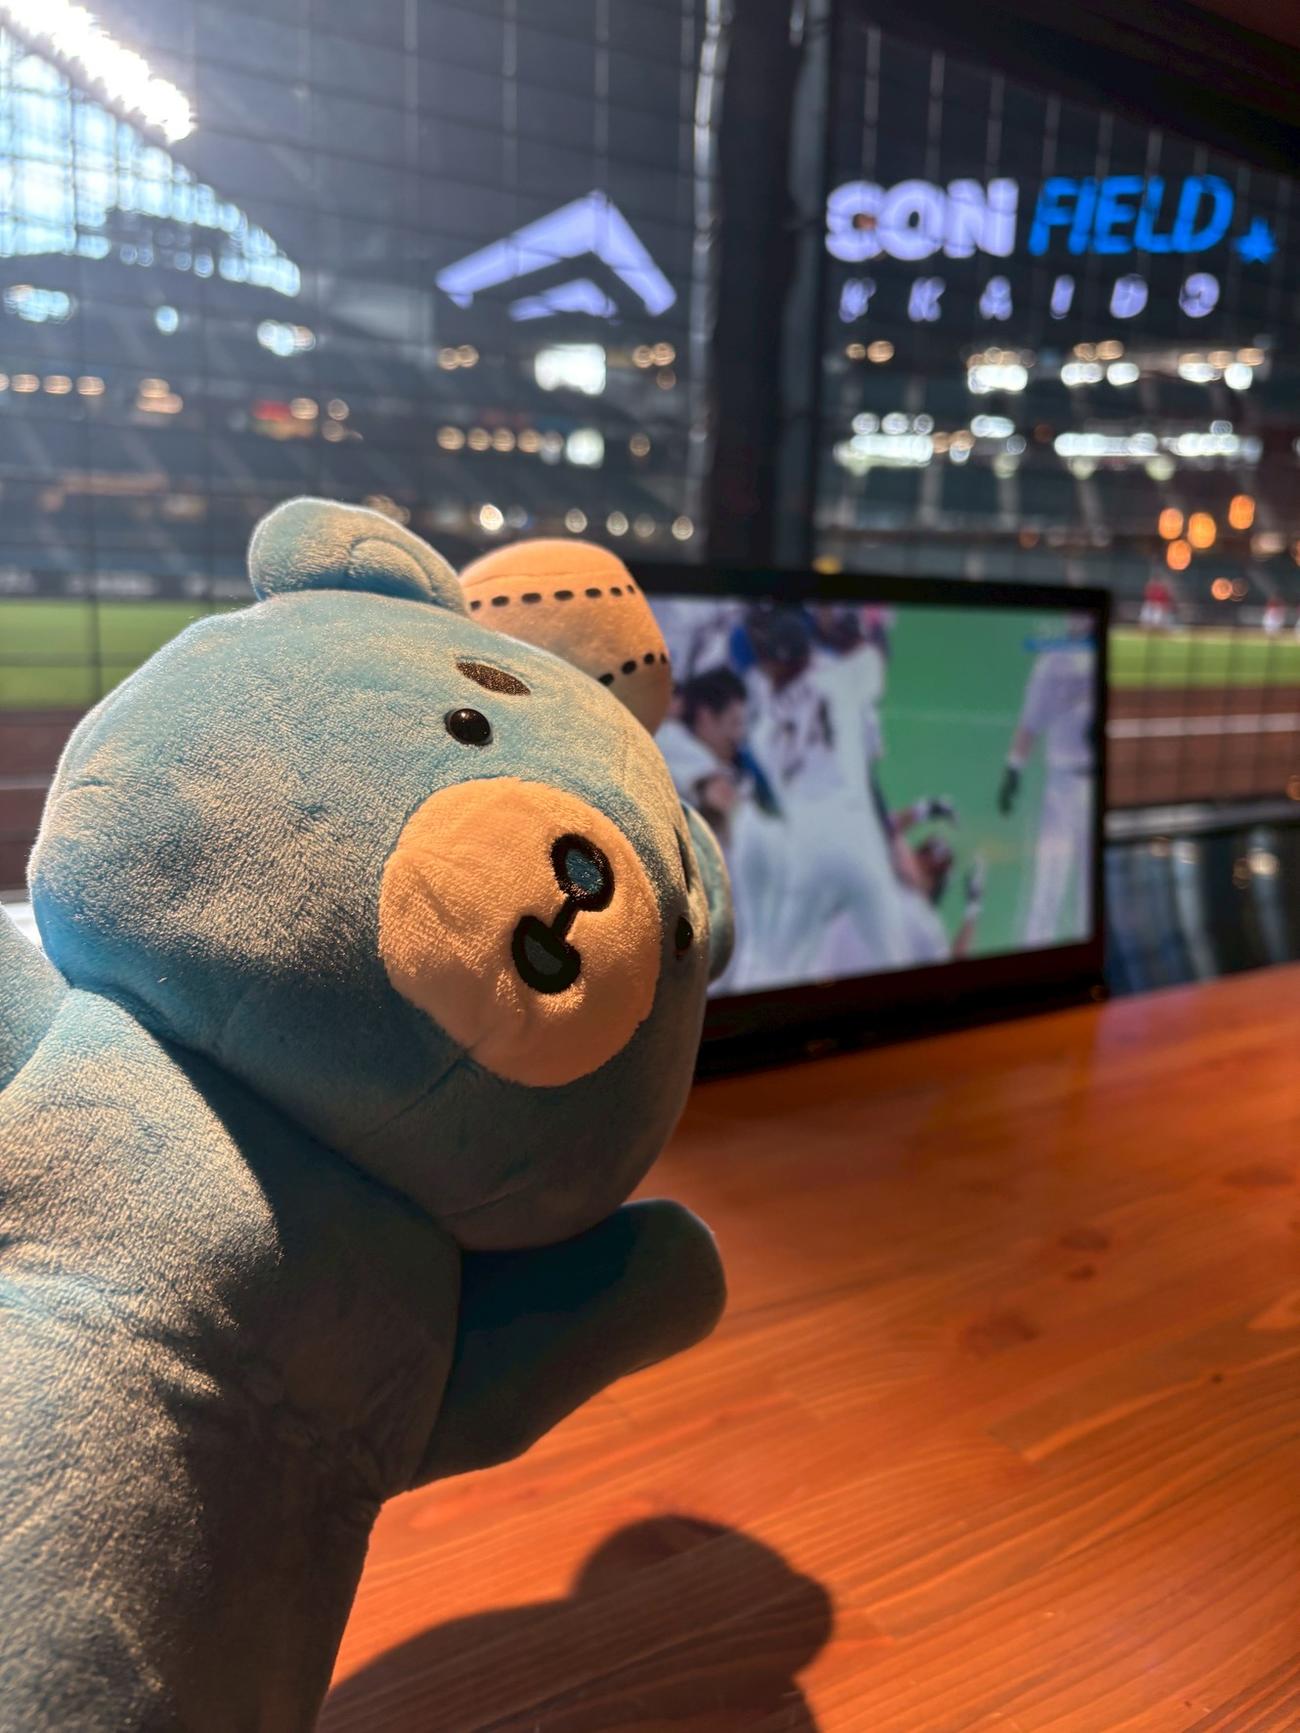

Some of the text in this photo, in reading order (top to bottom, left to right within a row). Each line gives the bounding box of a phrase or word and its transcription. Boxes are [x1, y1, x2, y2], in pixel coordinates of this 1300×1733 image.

[825, 175, 1234, 262] CON FIELD
[839, 272, 1220, 323] KKAIDO
